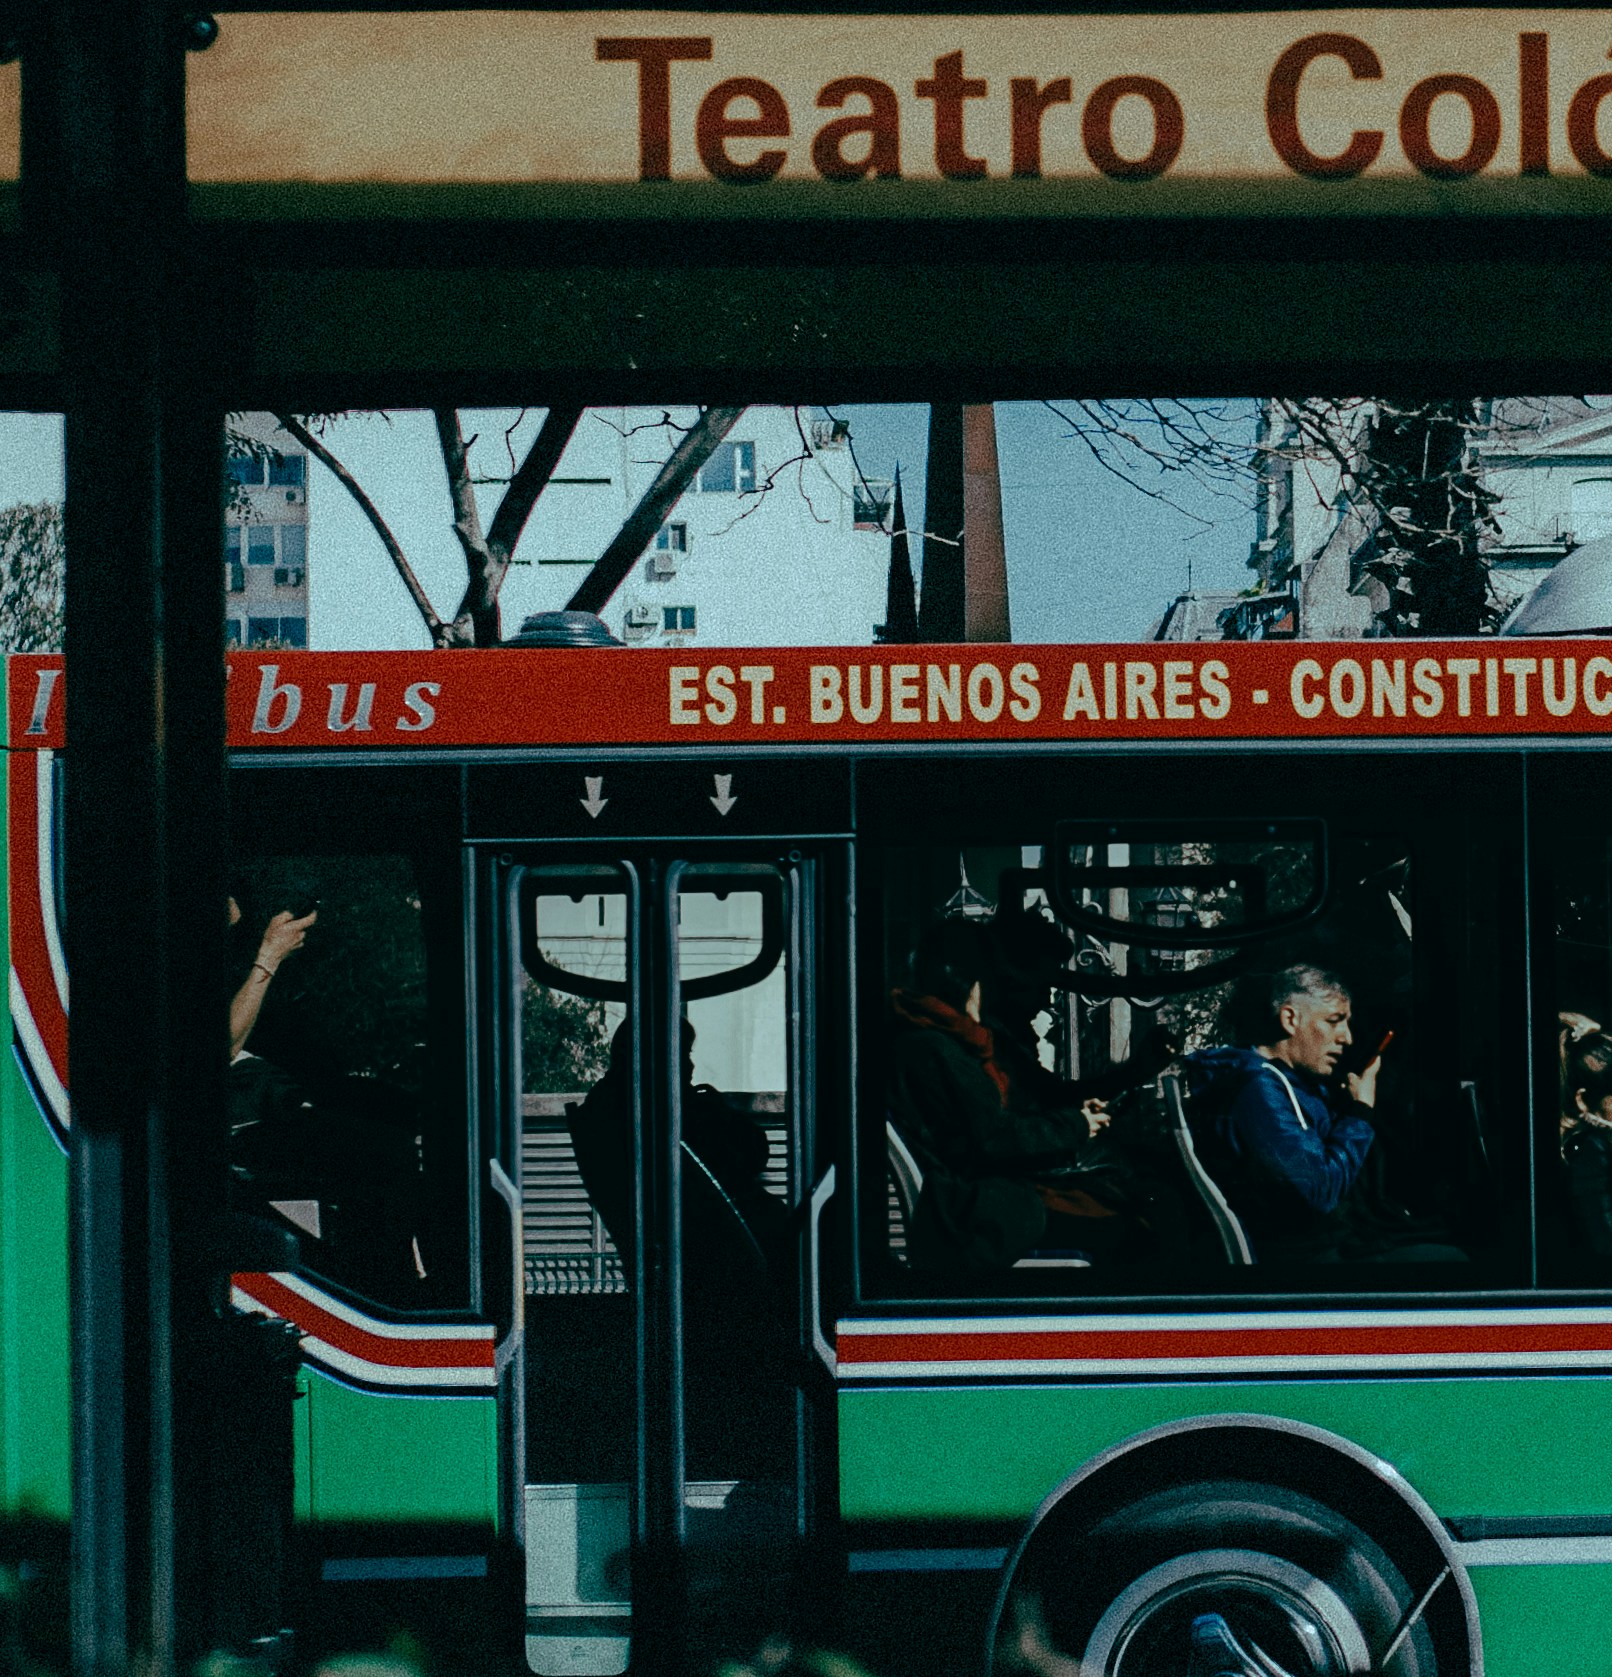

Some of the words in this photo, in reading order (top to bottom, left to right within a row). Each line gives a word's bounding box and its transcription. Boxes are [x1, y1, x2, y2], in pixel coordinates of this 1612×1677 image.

[594, 36, 1186, 182] Teatro
[669, 665, 786, 725] EST.
[810, 663, 1042, 723] BUENOS
[1062, 660, 1232, 720] AIRES
